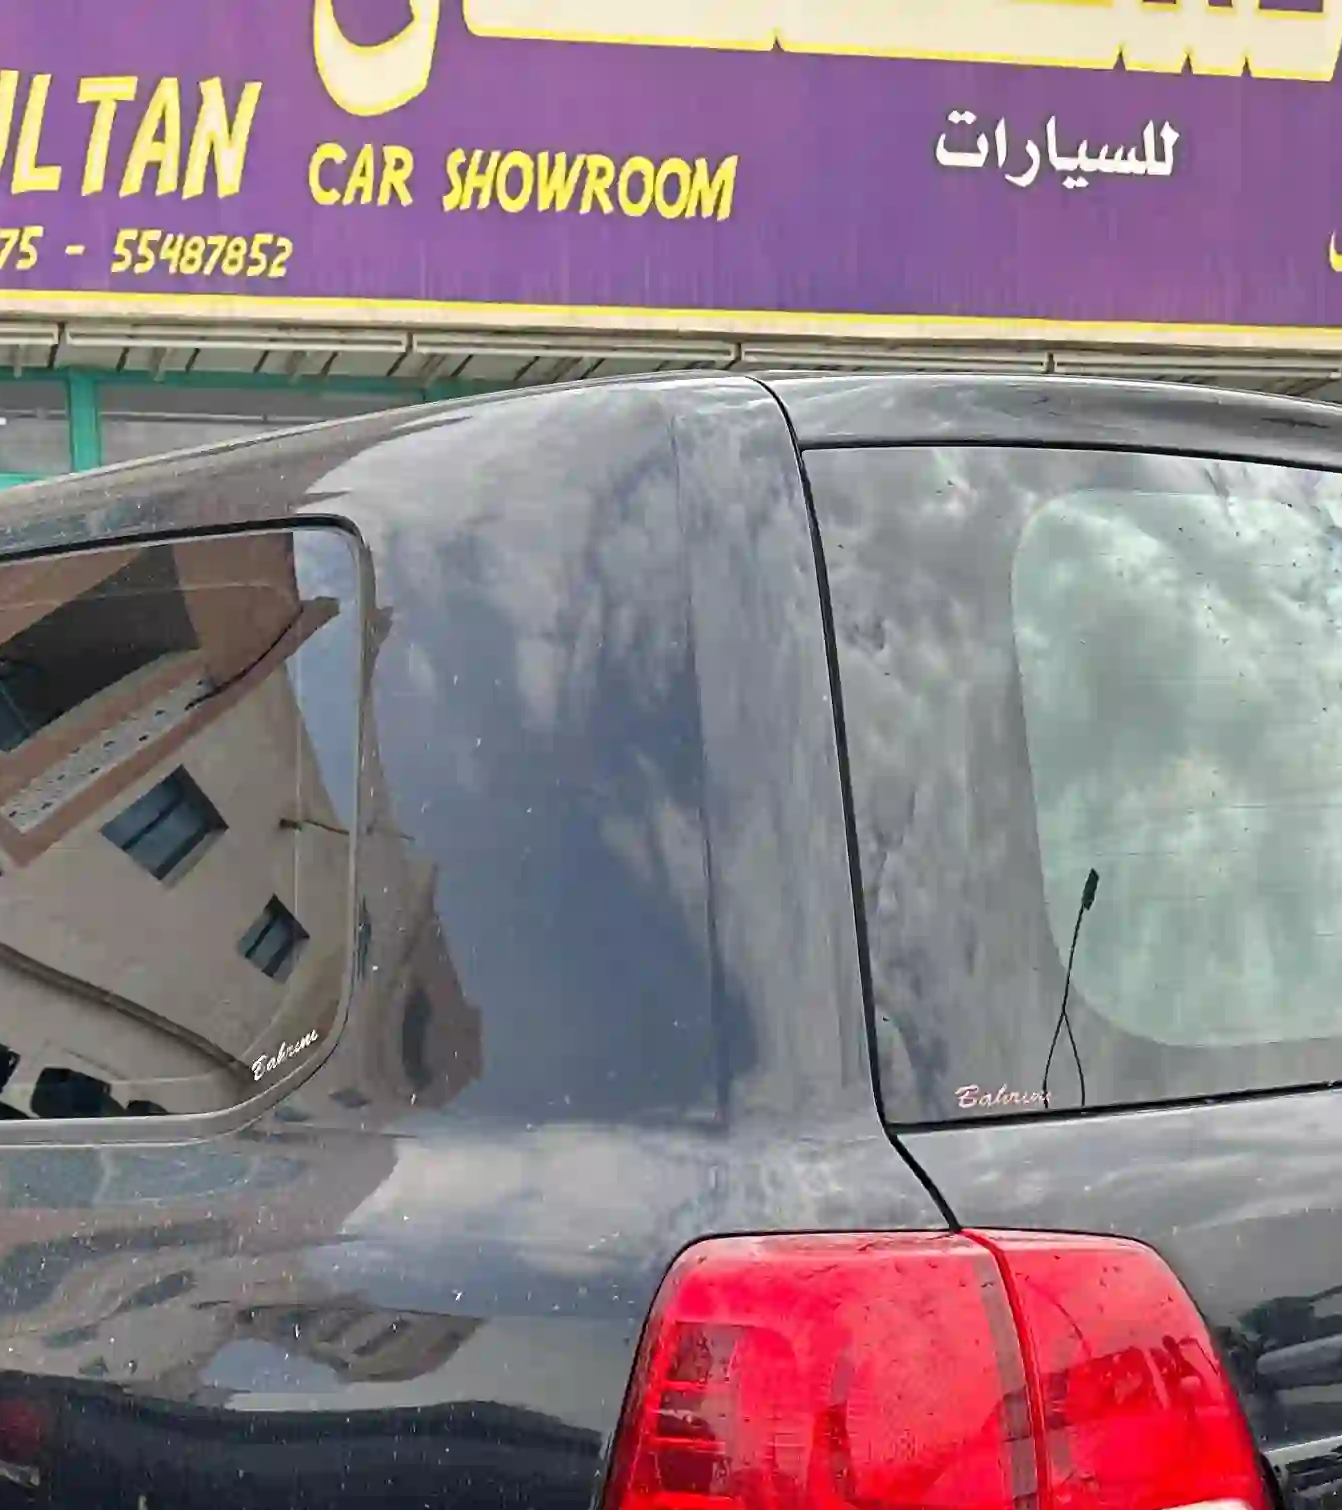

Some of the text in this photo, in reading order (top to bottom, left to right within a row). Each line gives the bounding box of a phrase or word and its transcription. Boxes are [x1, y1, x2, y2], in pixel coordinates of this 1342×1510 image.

[309, 143, 739, 221] CAR SHOWROOM
[936, 111, 1181, 189] للسيارات
[111, 229, 294, 278] 55487852
